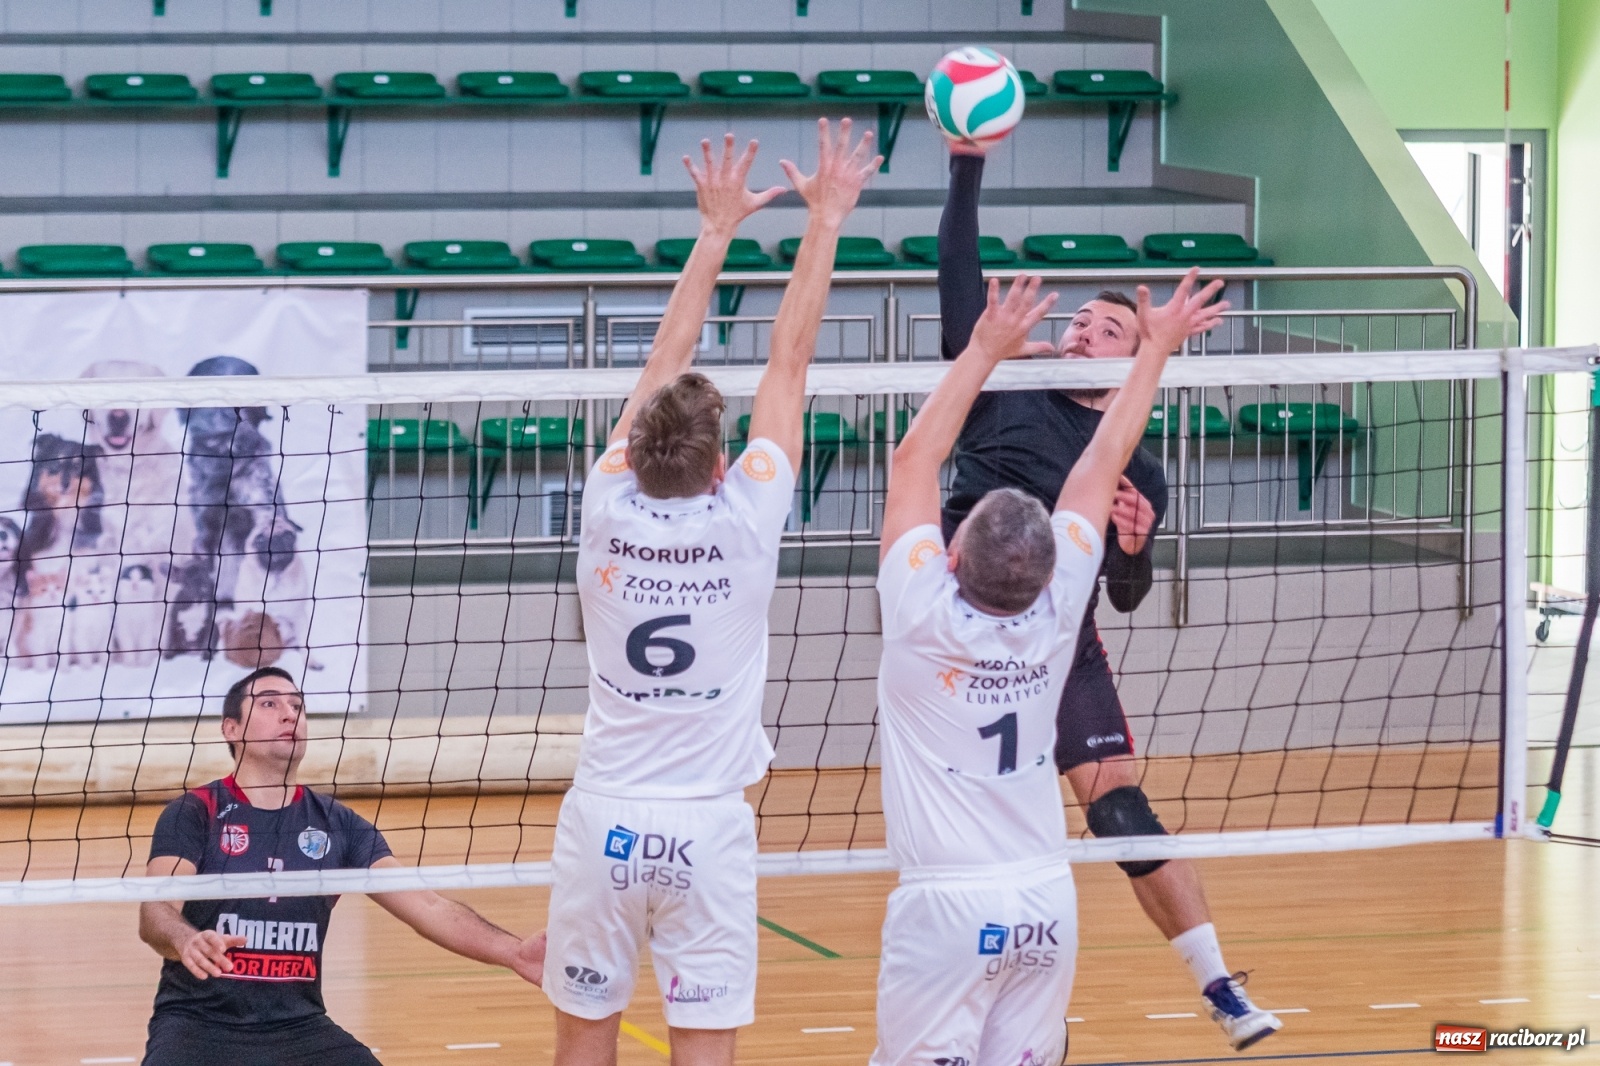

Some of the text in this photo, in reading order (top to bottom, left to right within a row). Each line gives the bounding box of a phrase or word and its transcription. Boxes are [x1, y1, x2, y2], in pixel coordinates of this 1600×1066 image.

[608, 538, 724, 564] SKORUPA
[622, 590, 732, 606] LUNATYCY
[626, 614, 696, 677] 6
[966, 678, 1050, 705] LUNATYCY
[977, 712, 1018, 775] 1
[642, 834, 695, 867] DK
[610, 857, 692, 891] glass
[1013, 920, 1059, 949] DK
[221, 952, 317, 977] ORTHERN
